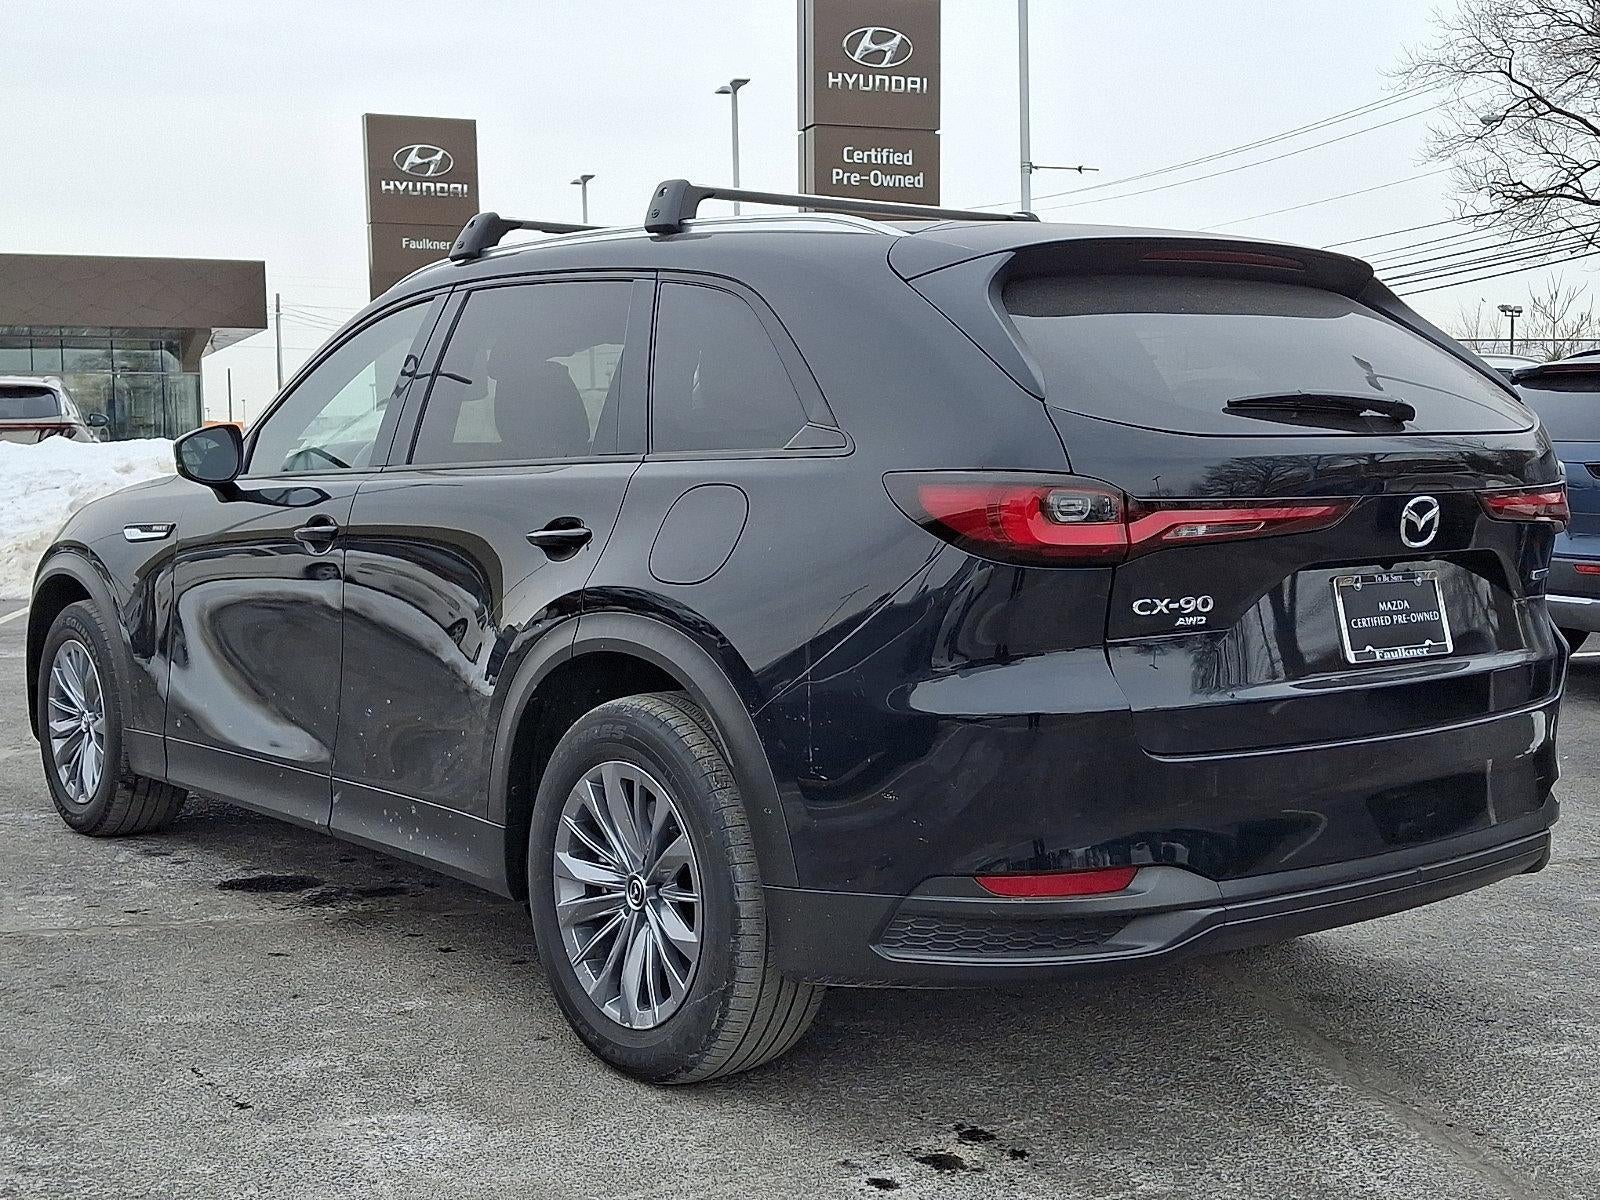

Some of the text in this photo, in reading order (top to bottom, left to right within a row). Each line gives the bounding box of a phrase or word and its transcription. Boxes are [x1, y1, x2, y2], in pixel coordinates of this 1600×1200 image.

[828, 71, 929, 94] HYUNDAI
[843, 146, 913, 166] Certified
[832, 168, 924, 189] Pre-Owned
[380, 179, 469, 198] HYUNDAI
[402, 237, 452, 250] Faulkner
[1132, 595, 1214, 615] CX-90
[1378, 599, 1410, 612] MAZDA
[1174, 616, 1207, 627] AWD
[1351, 610, 1440, 629] CERTIFIED PRE-OWNED
[1375, 647, 1430, 660] Faulkner
